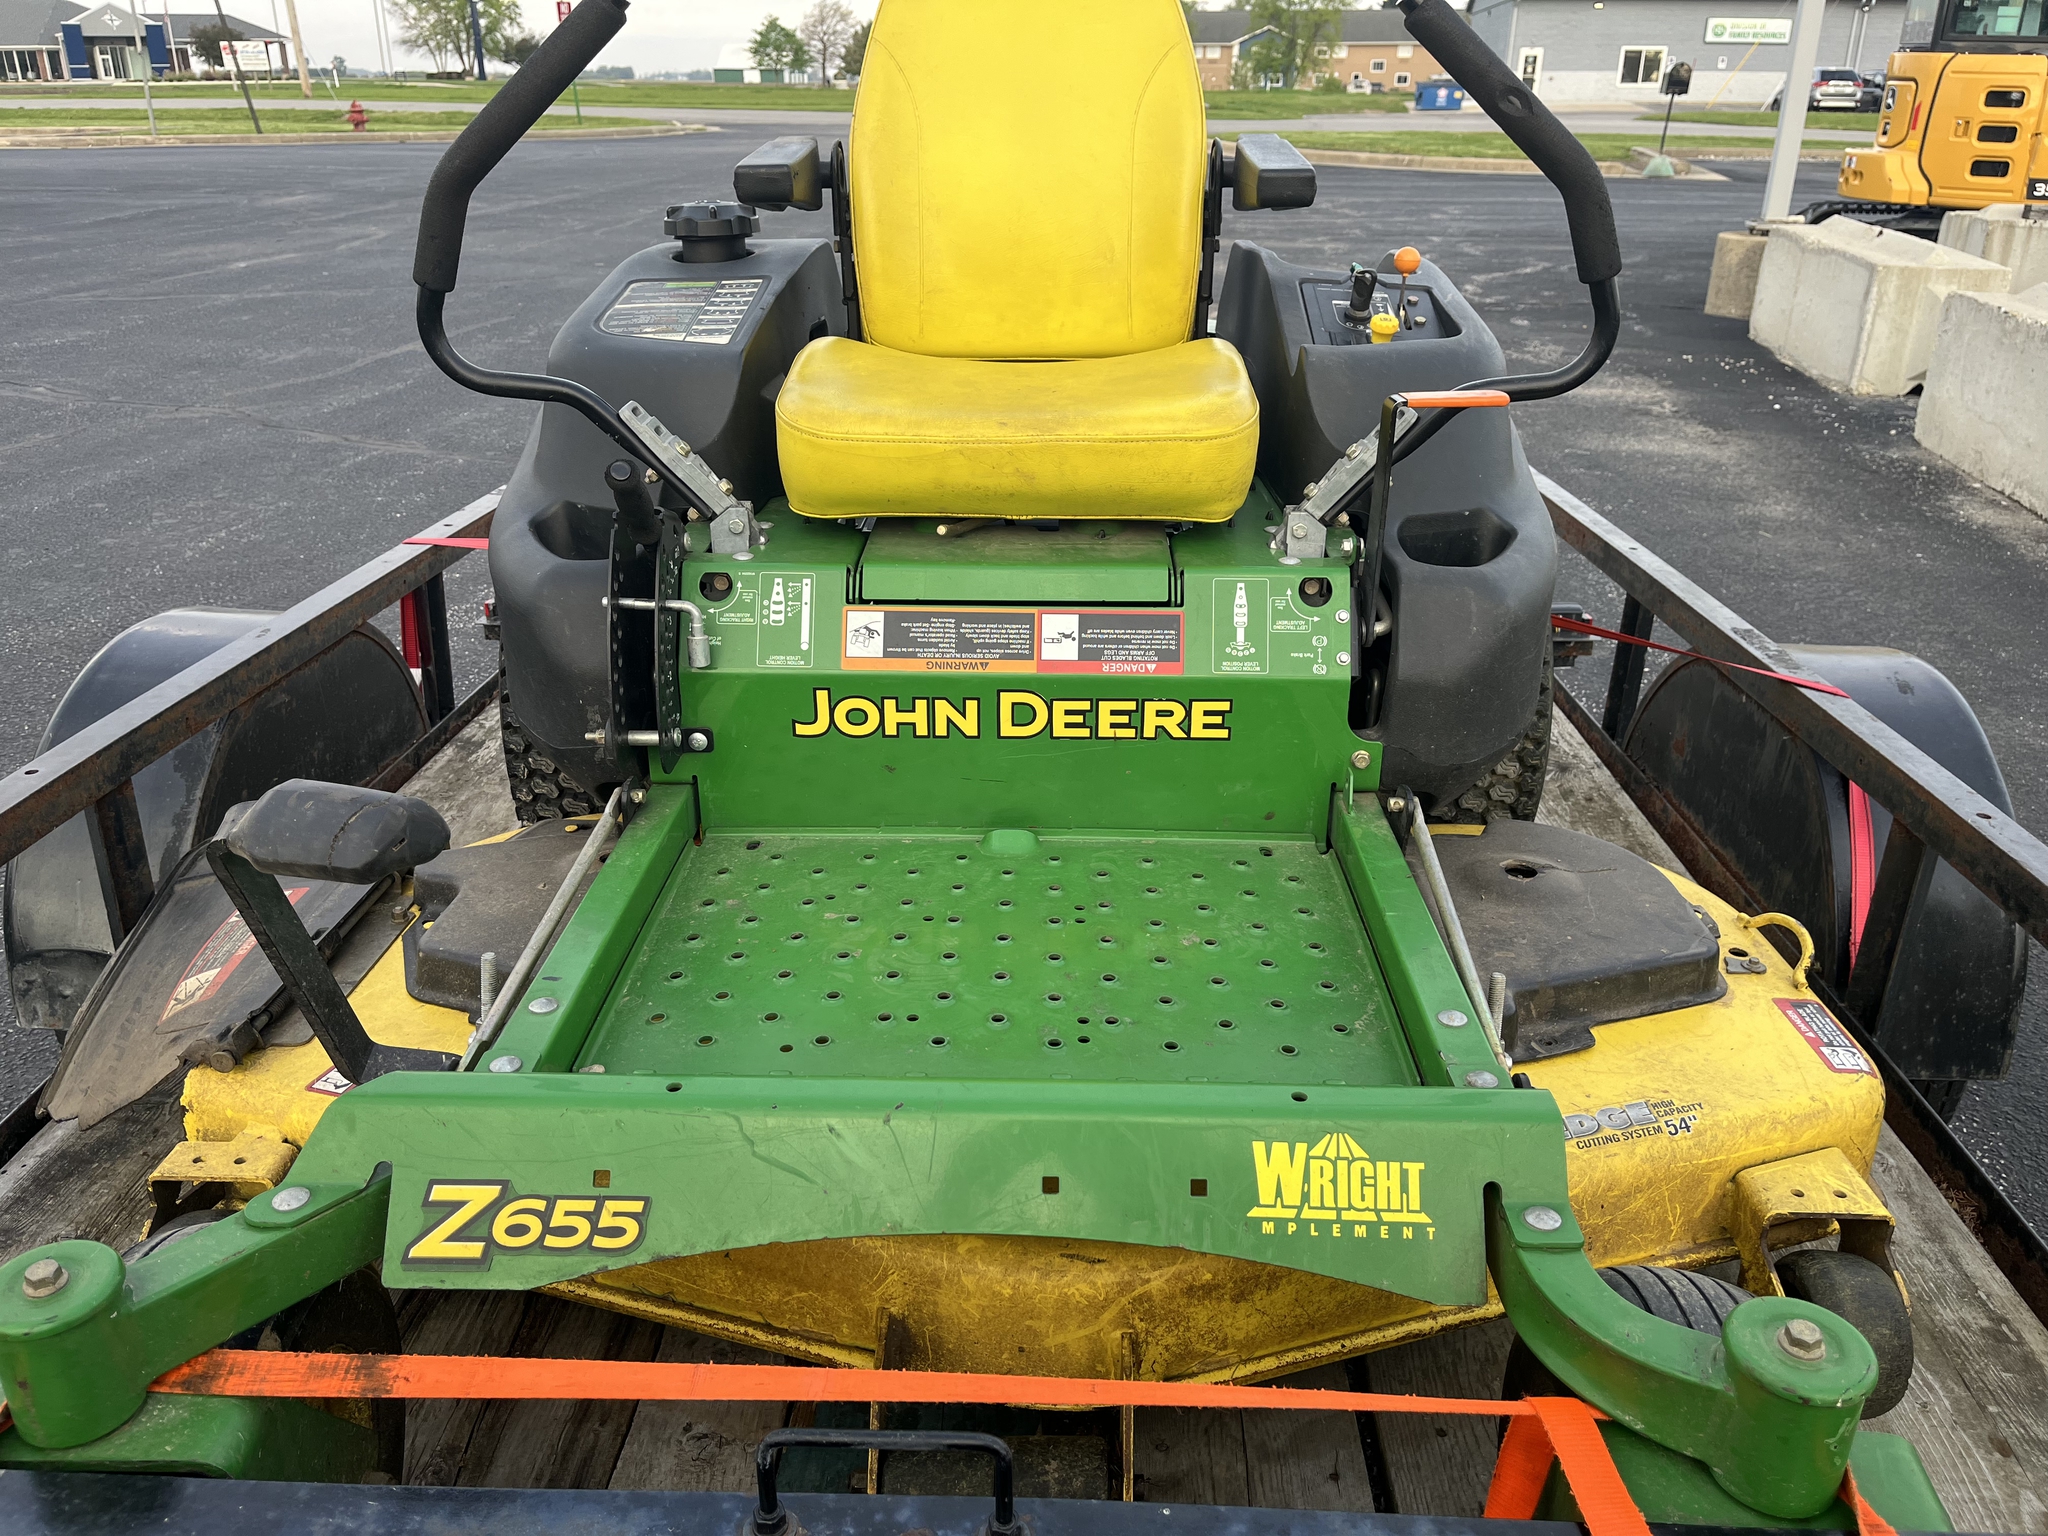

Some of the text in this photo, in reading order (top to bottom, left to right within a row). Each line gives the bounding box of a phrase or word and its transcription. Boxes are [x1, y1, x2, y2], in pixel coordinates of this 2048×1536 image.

[926, 661, 978, 670] WARNING
[1102, 663, 1145, 671] DANGER
[792, 687, 1233, 740] JOHN DEERE
[1786, 1010, 1809, 1032] DANGER
[1651, 1100, 1675, 1110] HIGH
[1656, 1102, 1704, 1118] CAPACITY
[1576, 1125, 1663, 1150] CUTTING SYSTEM
[1252, 1140, 1424, 1210] WRIGHT
[402, 1180, 651, 1264] Z655
